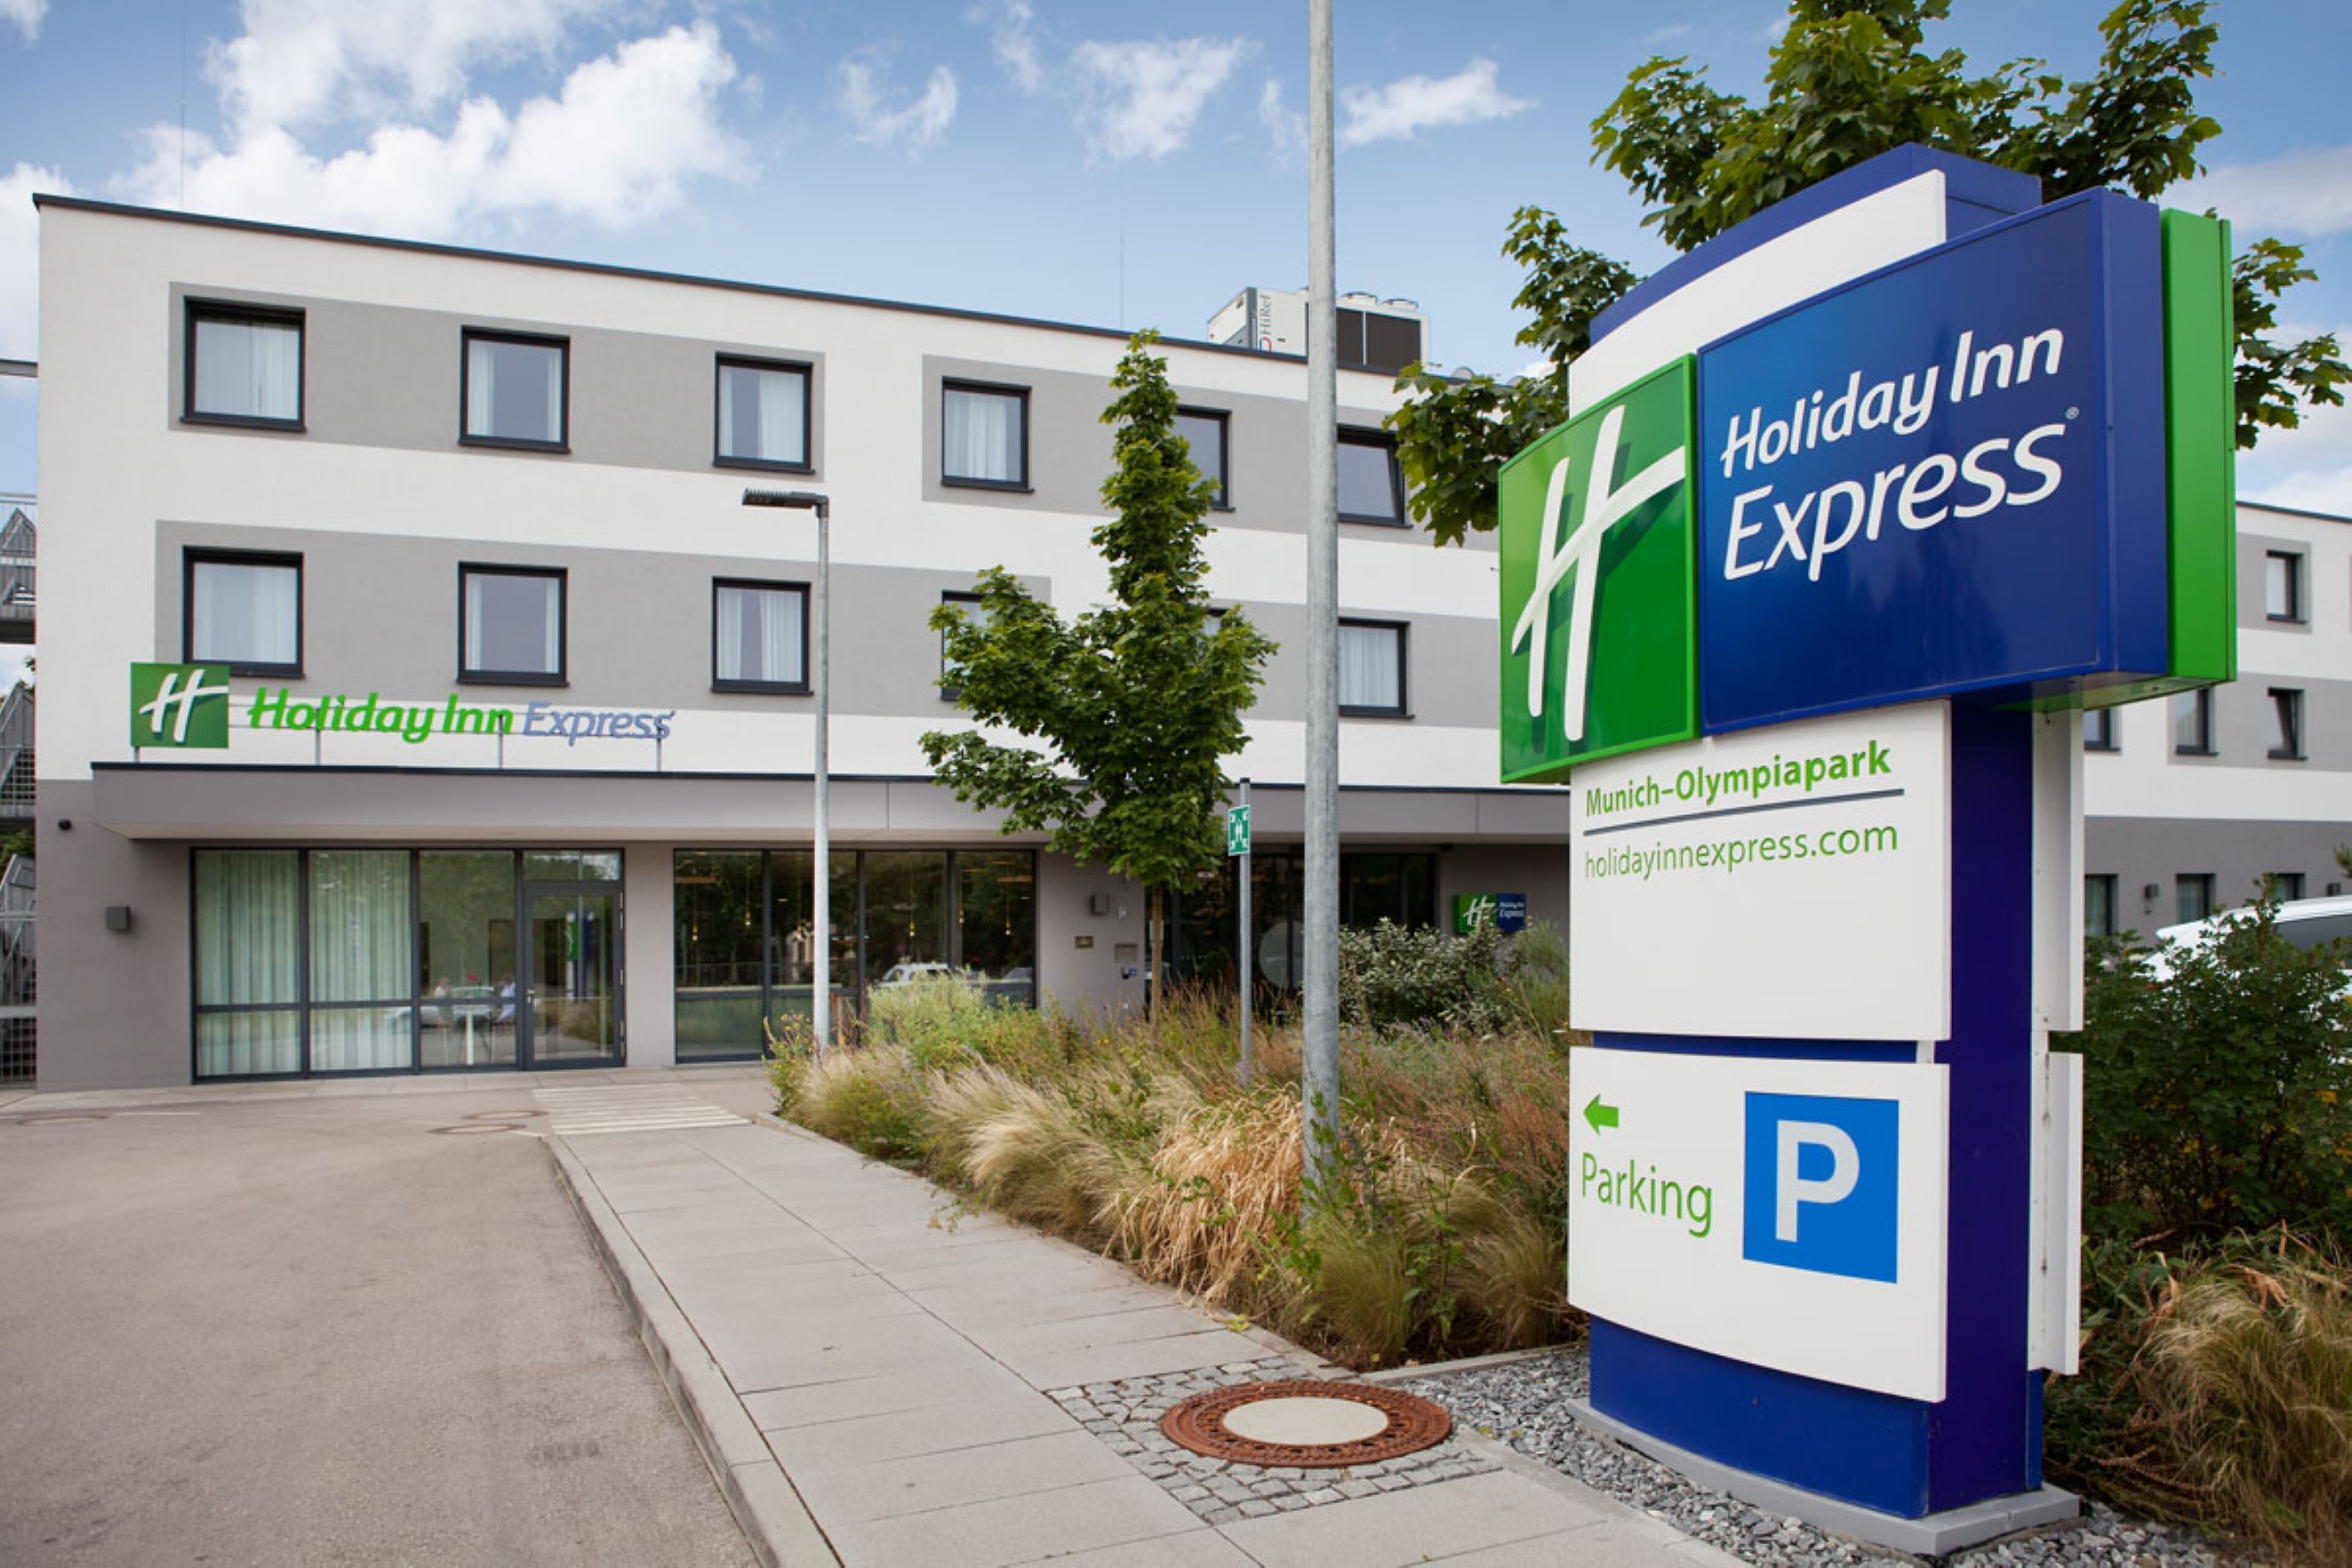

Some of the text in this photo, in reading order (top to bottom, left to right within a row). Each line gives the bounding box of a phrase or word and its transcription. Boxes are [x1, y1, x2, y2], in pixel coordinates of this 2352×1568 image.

[1720, 328, 2064, 477] Holiday Inn
[1723, 422, 2067, 582] Express
[247, 687, 676, 746] Holiday Inn Express
[1586, 740, 1891, 817] Munich-Olympiapark
[1585, 824, 1898, 880] holidayinnexpress.com
[1581, 1152, 1713, 1239] Parking
[1776, 1120, 1860, 1243] P
